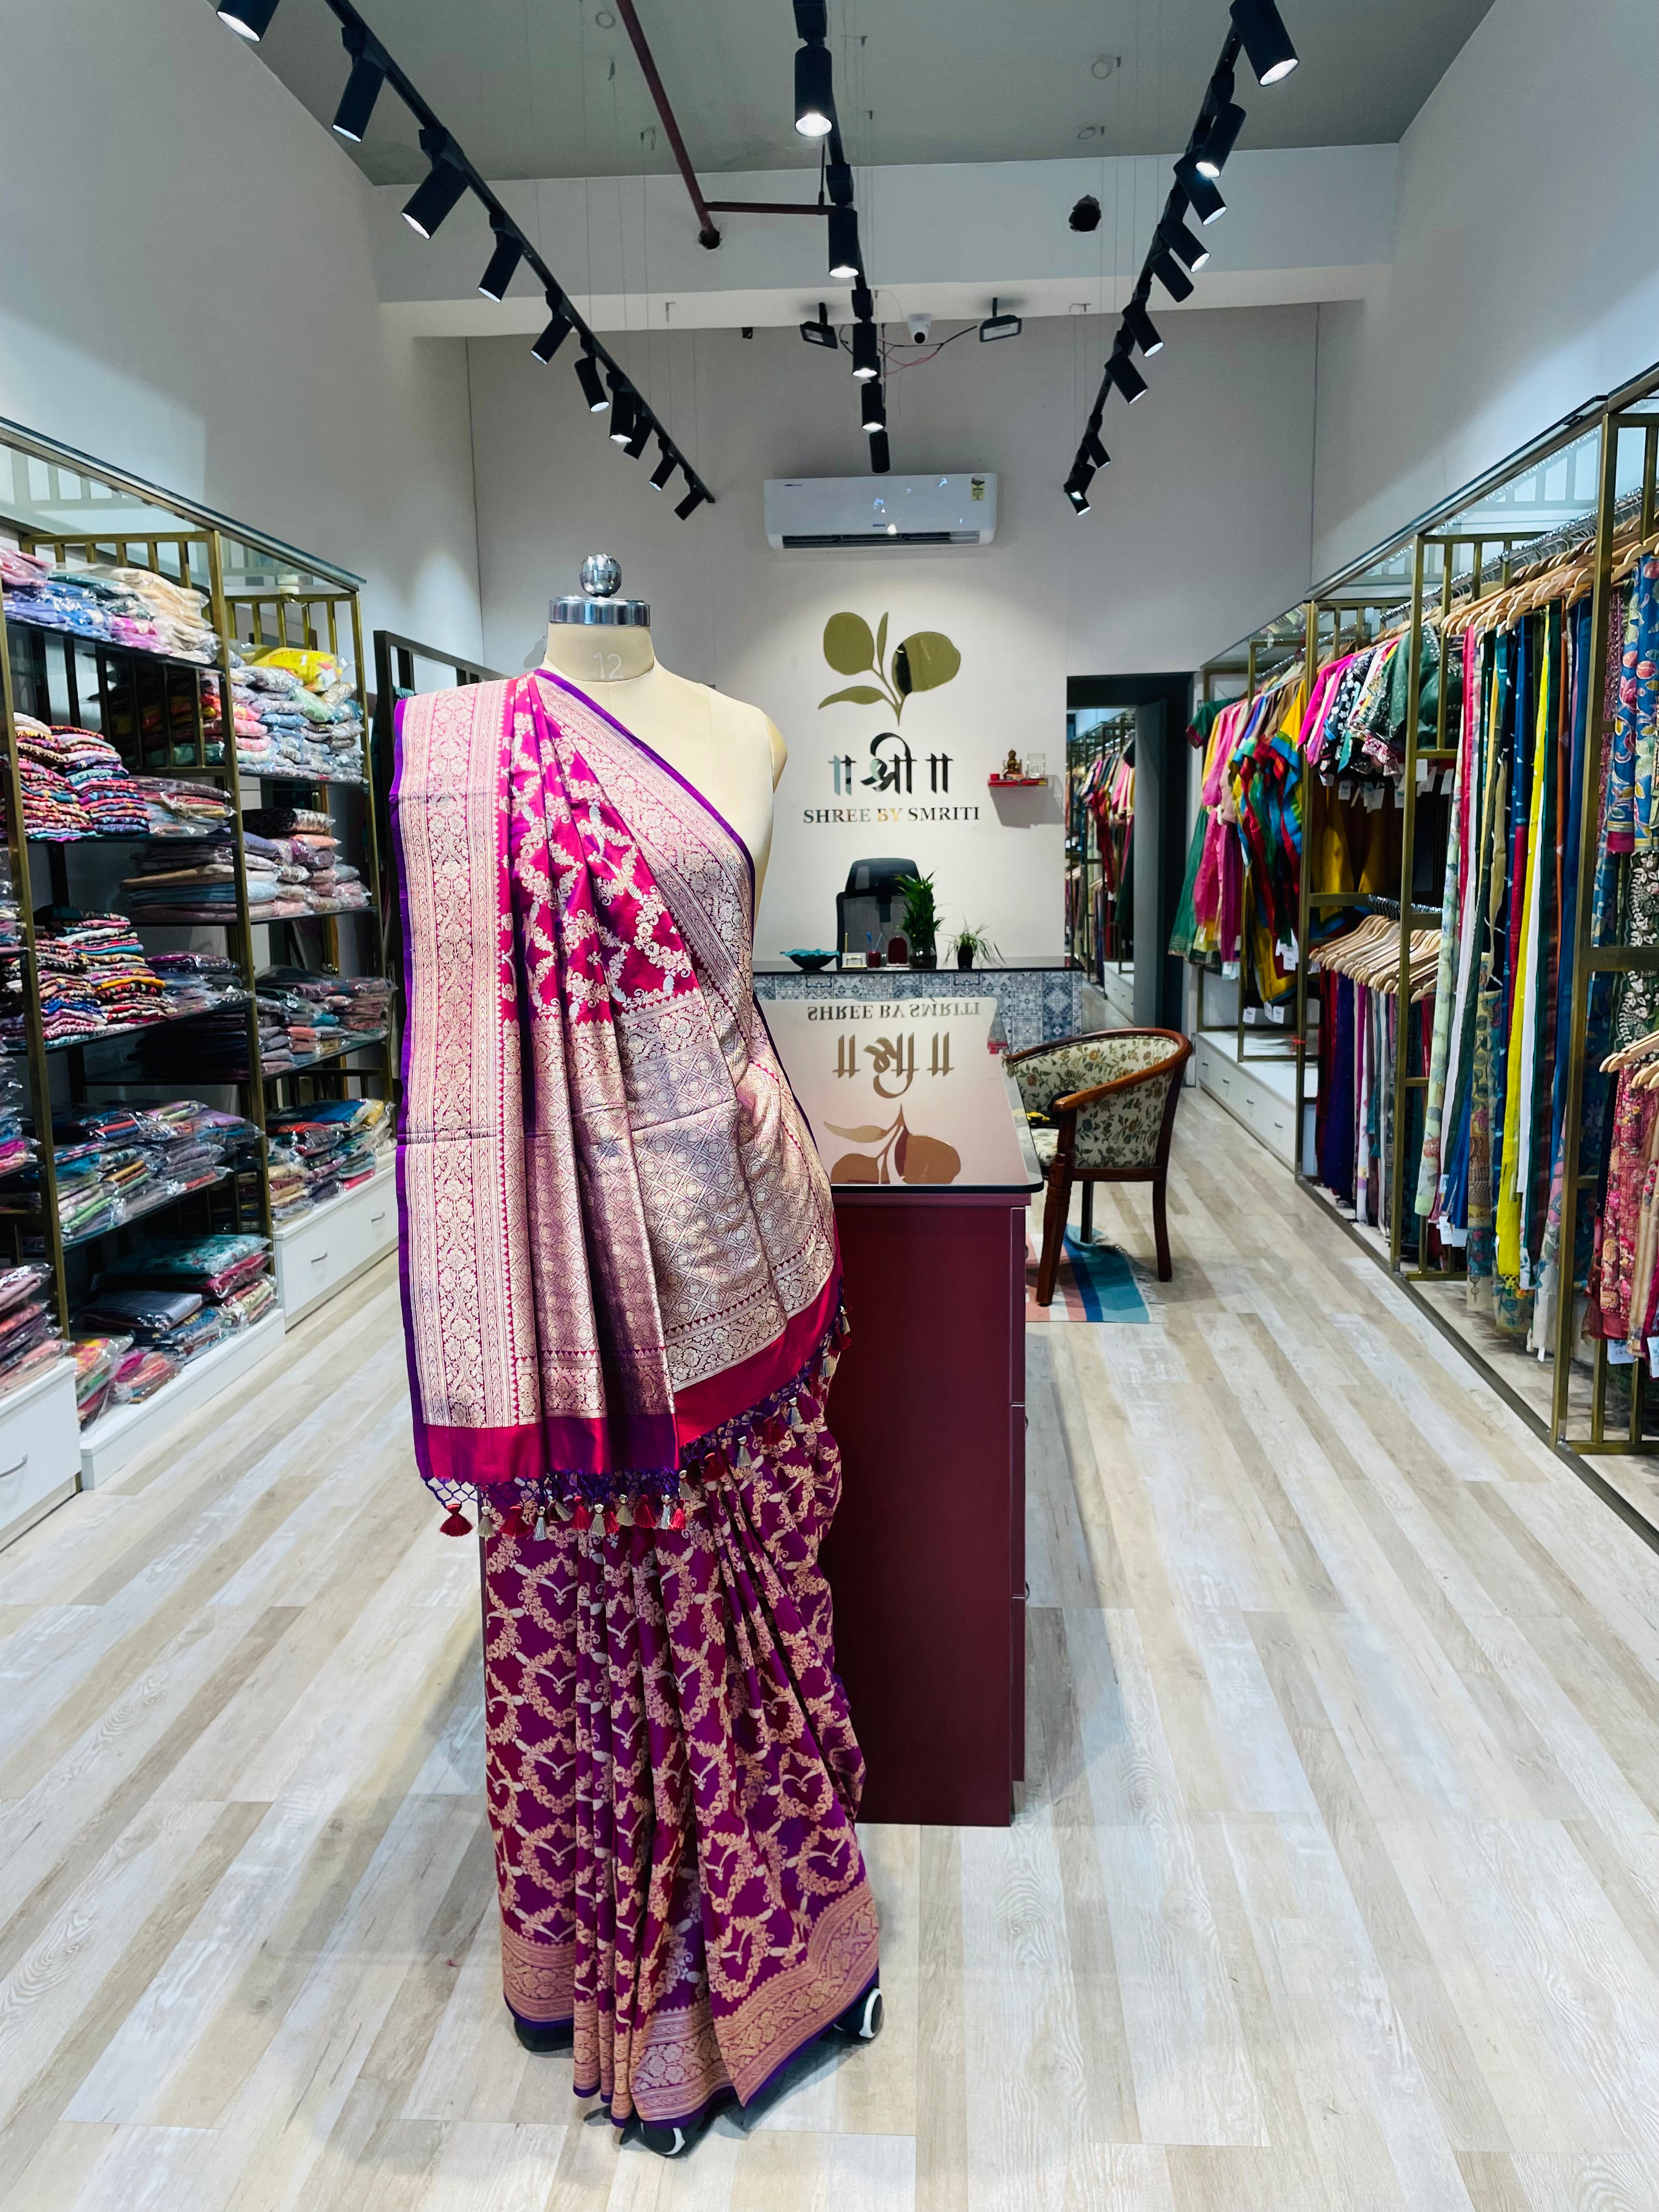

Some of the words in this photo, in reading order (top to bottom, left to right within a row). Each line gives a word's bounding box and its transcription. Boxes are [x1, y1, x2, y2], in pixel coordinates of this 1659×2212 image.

[592, 651, 623, 679] 12
[803, 809, 871, 823] SHREE
[876, 808, 903, 822] BY
[907, 806, 980, 821] SMRITI
